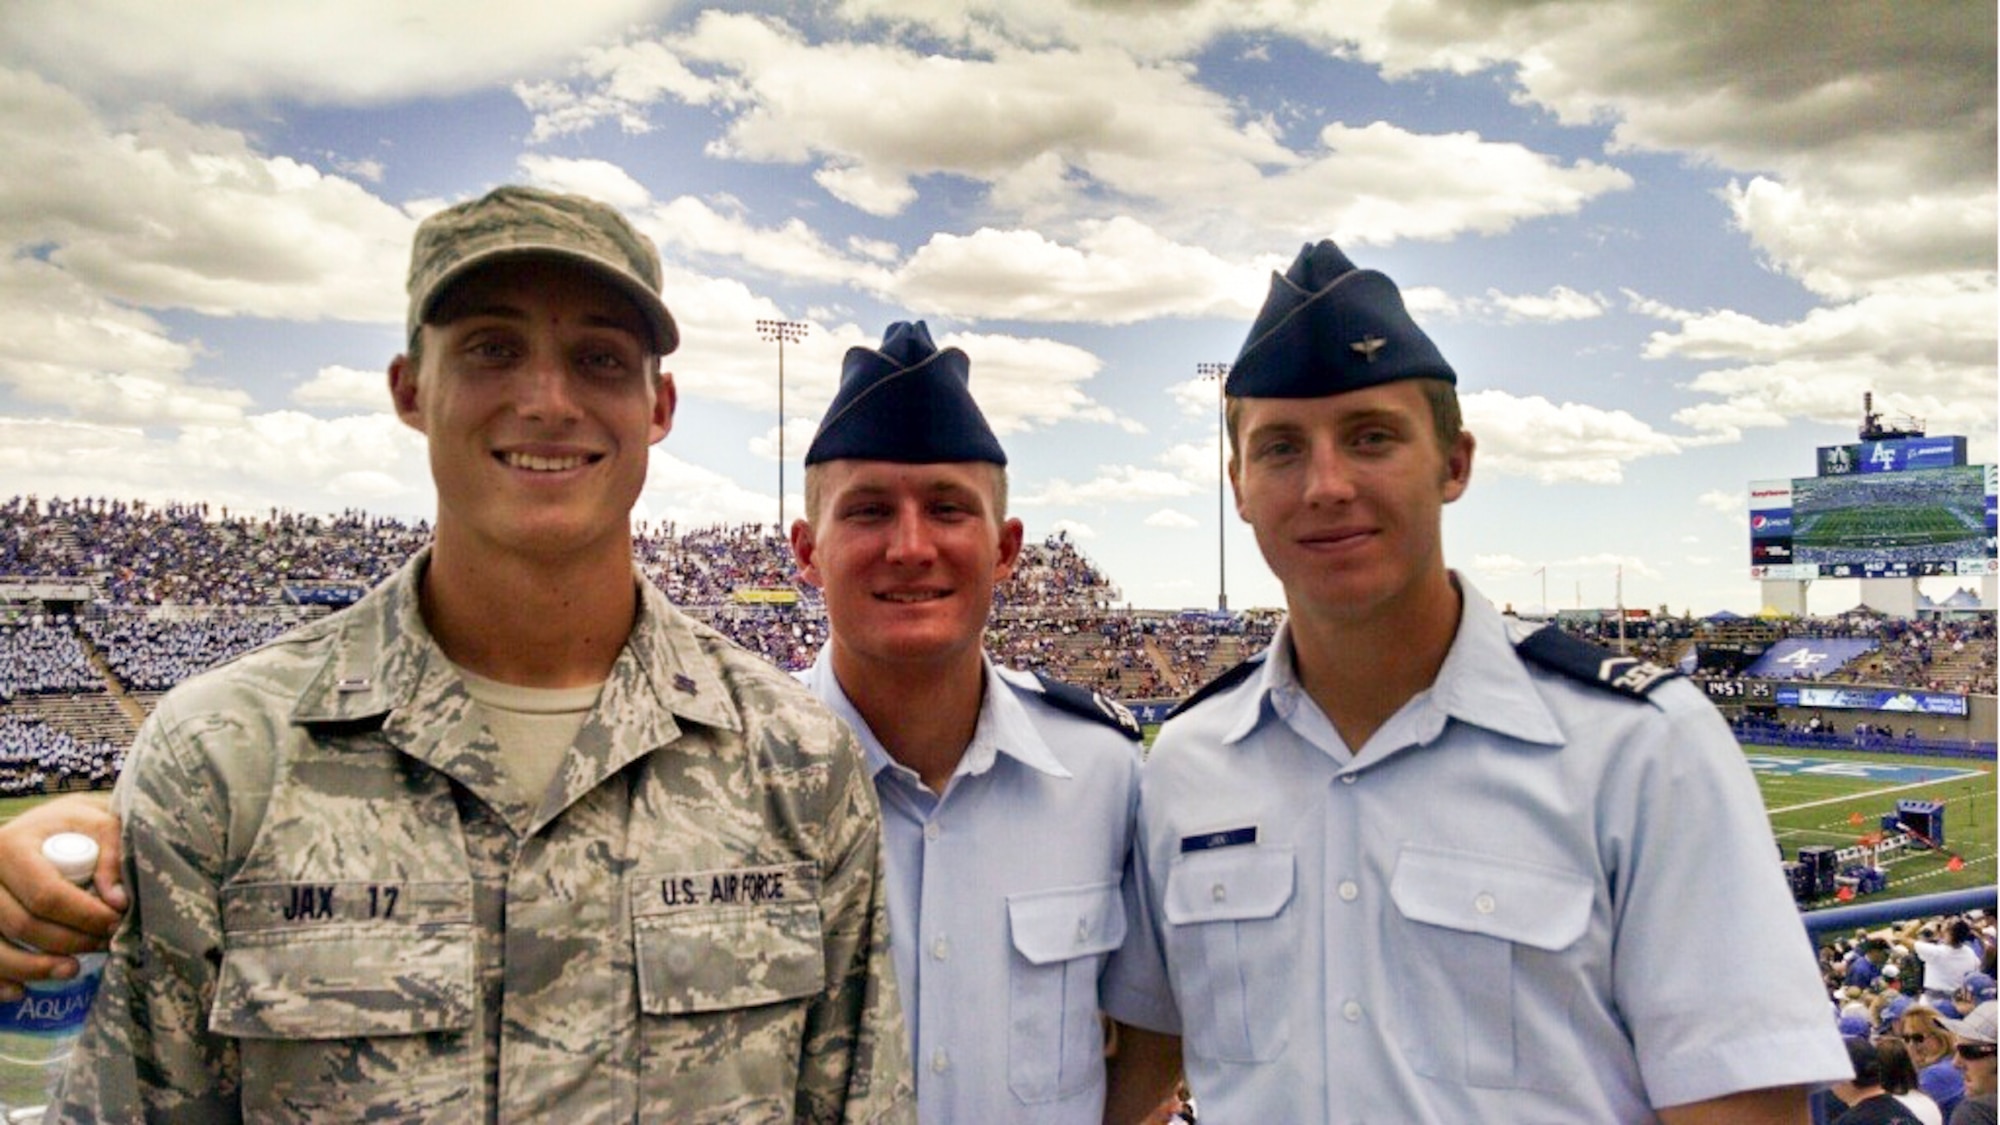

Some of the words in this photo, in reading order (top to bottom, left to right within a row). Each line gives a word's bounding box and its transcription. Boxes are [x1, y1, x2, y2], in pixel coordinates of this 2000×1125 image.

[1870, 442, 1896, 470] AF
[1777, 648, 1828, 669] AF
[1753, 684, 1769, 697] 25
[283, 885, 333, 920] JAX
[368, 885, 398, 918] 17
[661, 878, 699, 905] U.S.
[710, 874, 738, 904] AIR
[741, 872, 784, 902] FORCE
